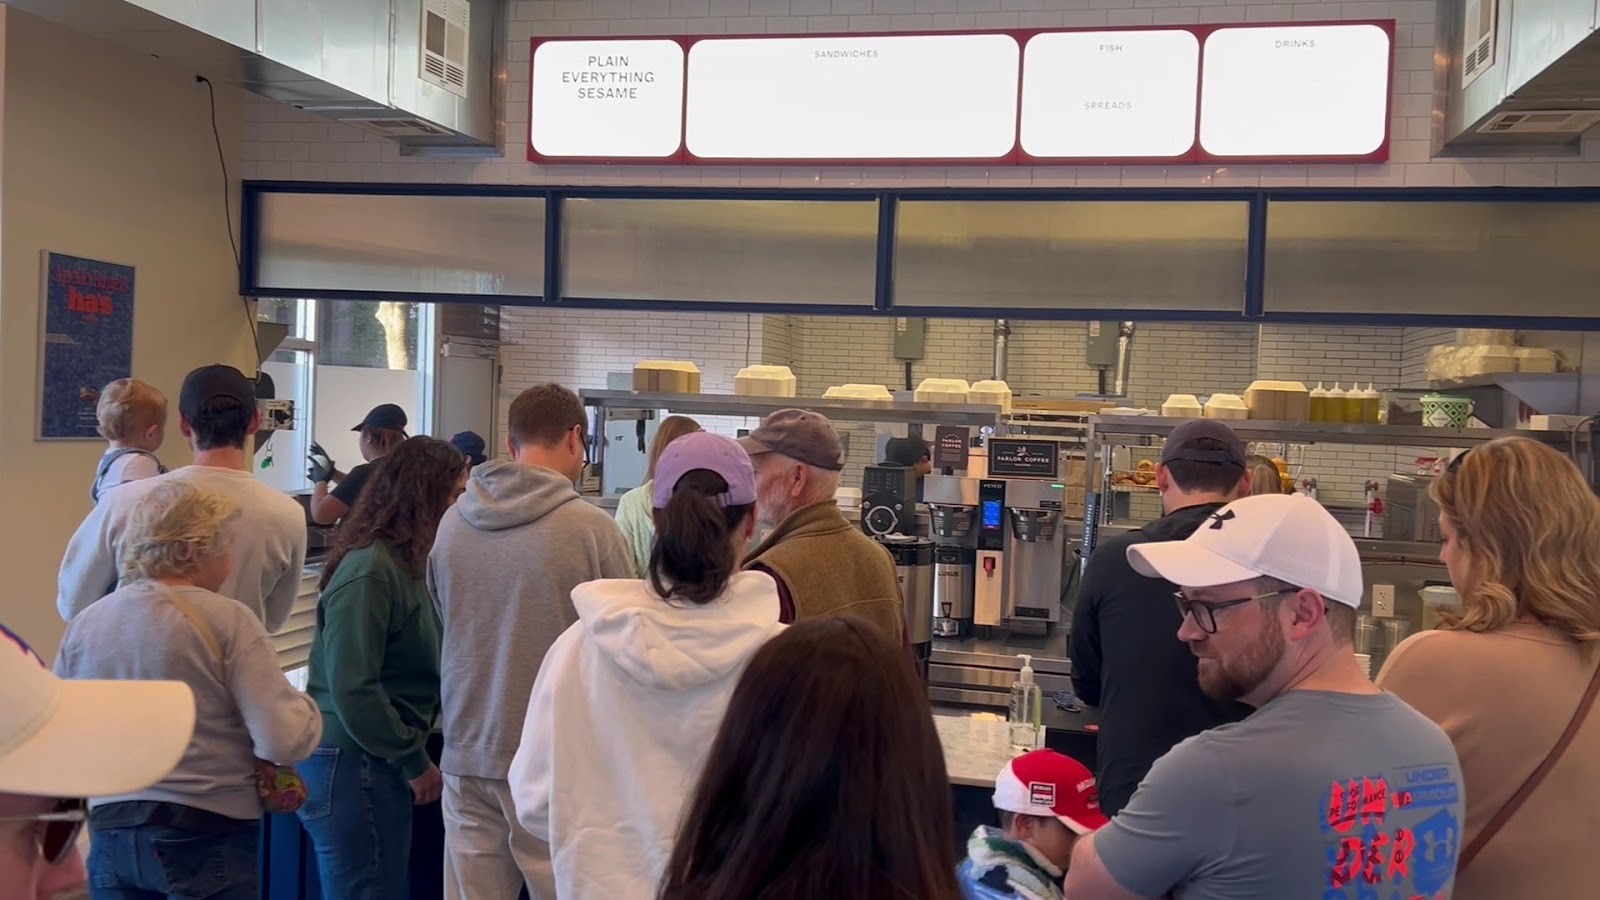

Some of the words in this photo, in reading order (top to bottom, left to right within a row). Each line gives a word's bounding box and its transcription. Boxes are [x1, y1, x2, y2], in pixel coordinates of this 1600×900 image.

[1099, 43, 1123, 53] FISH
[1274, 39, 1316, 49] DRINKS
[814, 49, 878, 59] SANDWICHES
[588, 55, 629, 67] PLAIN
[562, 71, 655, 83] EVERYTHING
[577, 87, 638, 99] SESAME
[1084, 101, 1132, 110] SPREADS
[67, 287, 113, 316] has
[997, 455, 1022, 463] PARLOR
